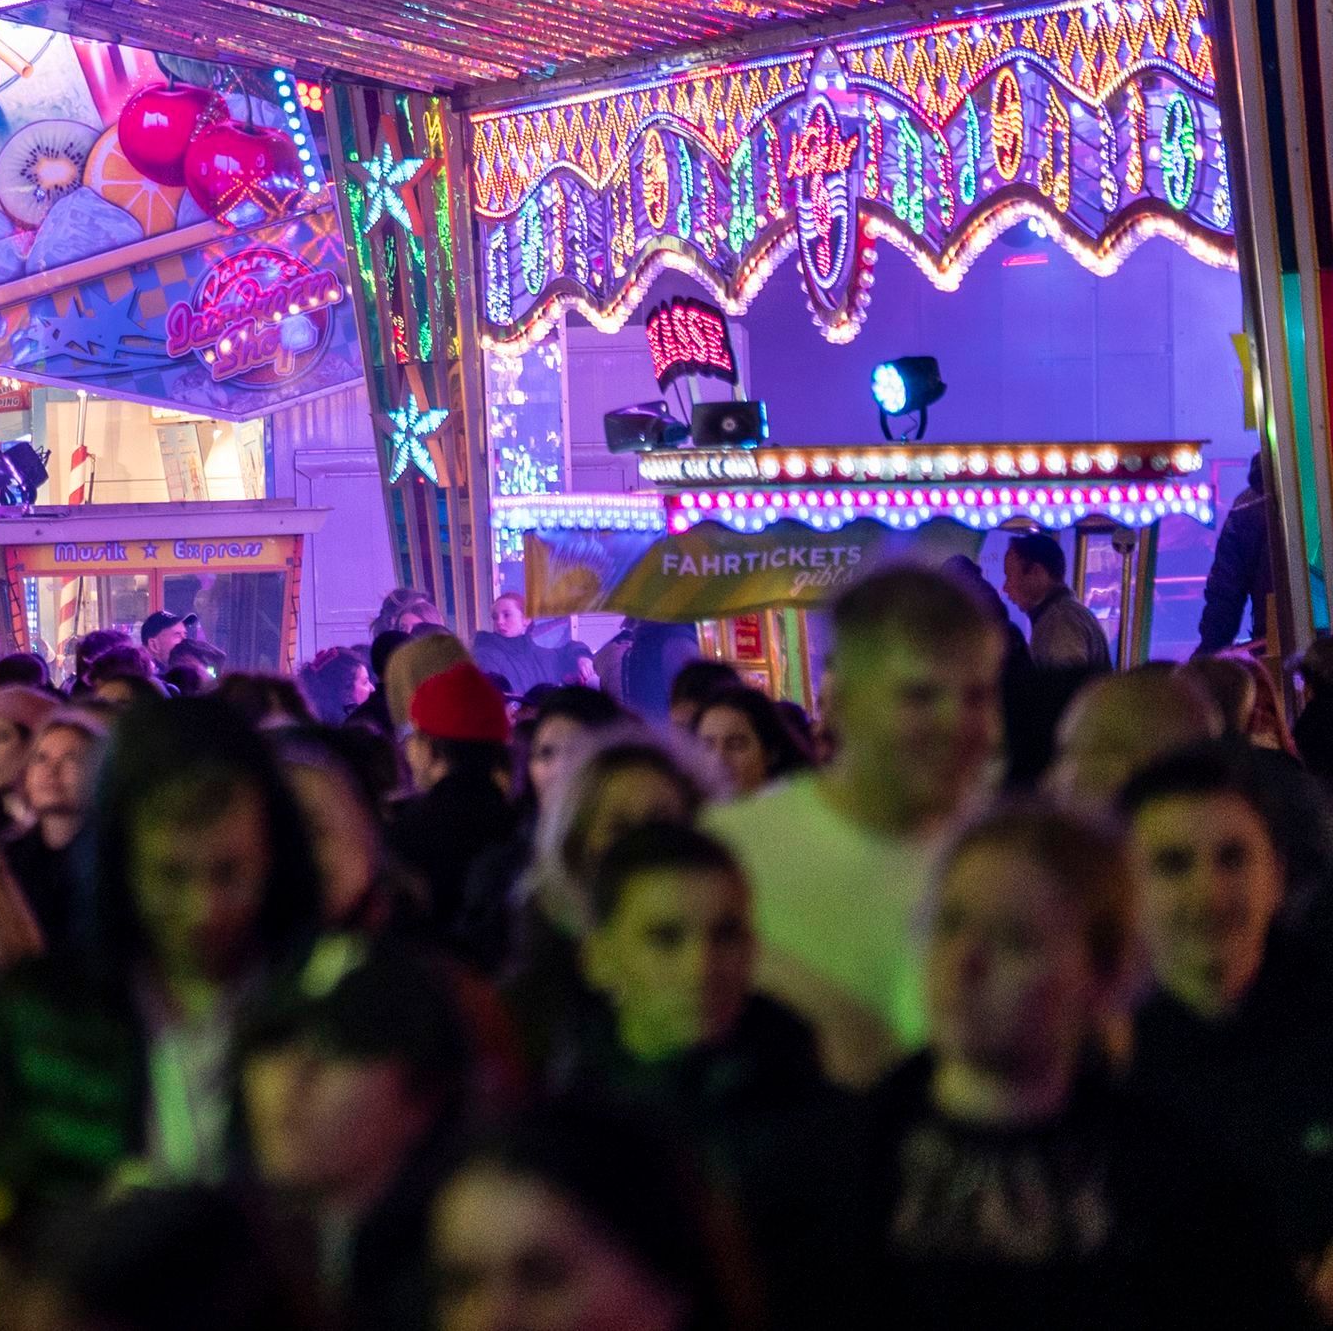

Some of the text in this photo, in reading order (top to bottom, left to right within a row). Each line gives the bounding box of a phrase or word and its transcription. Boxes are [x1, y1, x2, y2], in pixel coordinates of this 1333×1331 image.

[54, 539, 263, 564] Musik Express
[662, 546, 862, 577] FAHRTICKETS
